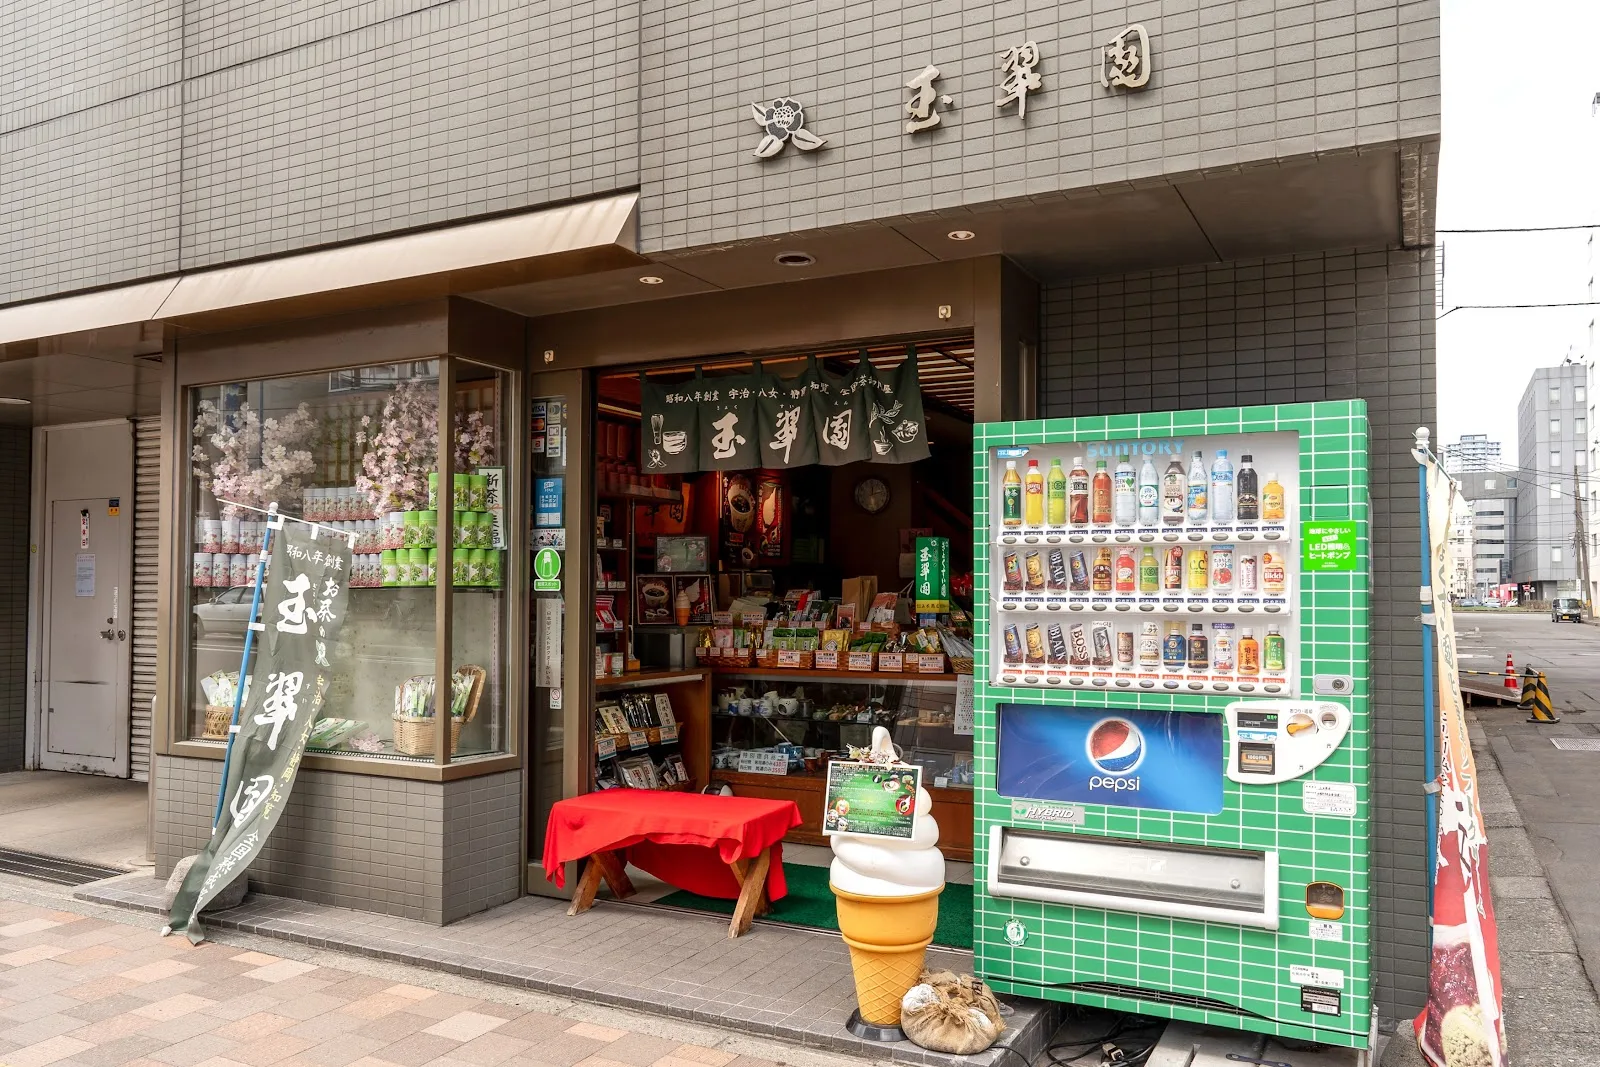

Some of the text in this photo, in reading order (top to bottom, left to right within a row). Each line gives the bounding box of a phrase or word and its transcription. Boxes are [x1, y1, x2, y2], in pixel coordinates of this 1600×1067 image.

[905, 23, 1151, 134] 玉翠園
[665, 390, 720, 403] 昭和八年創業
[711, 406, 852, 464] 玉翠園
[487, 472, 498, 503] 新茶
[286, 544, 344, 570] 昭和八年創業
[920, 547, 932, 595] 玉翠園
[1051, 551, 1066, 585] BLACK
[1052, 627, 1067, 660] BLACK
[1073, 629, 1088, 661] BOSS
[230, 573, 317, 828] 玉翠園
[1089, 776, 1141, 792] pepsi
[1025, 807, 1074, 818] HYBRID
